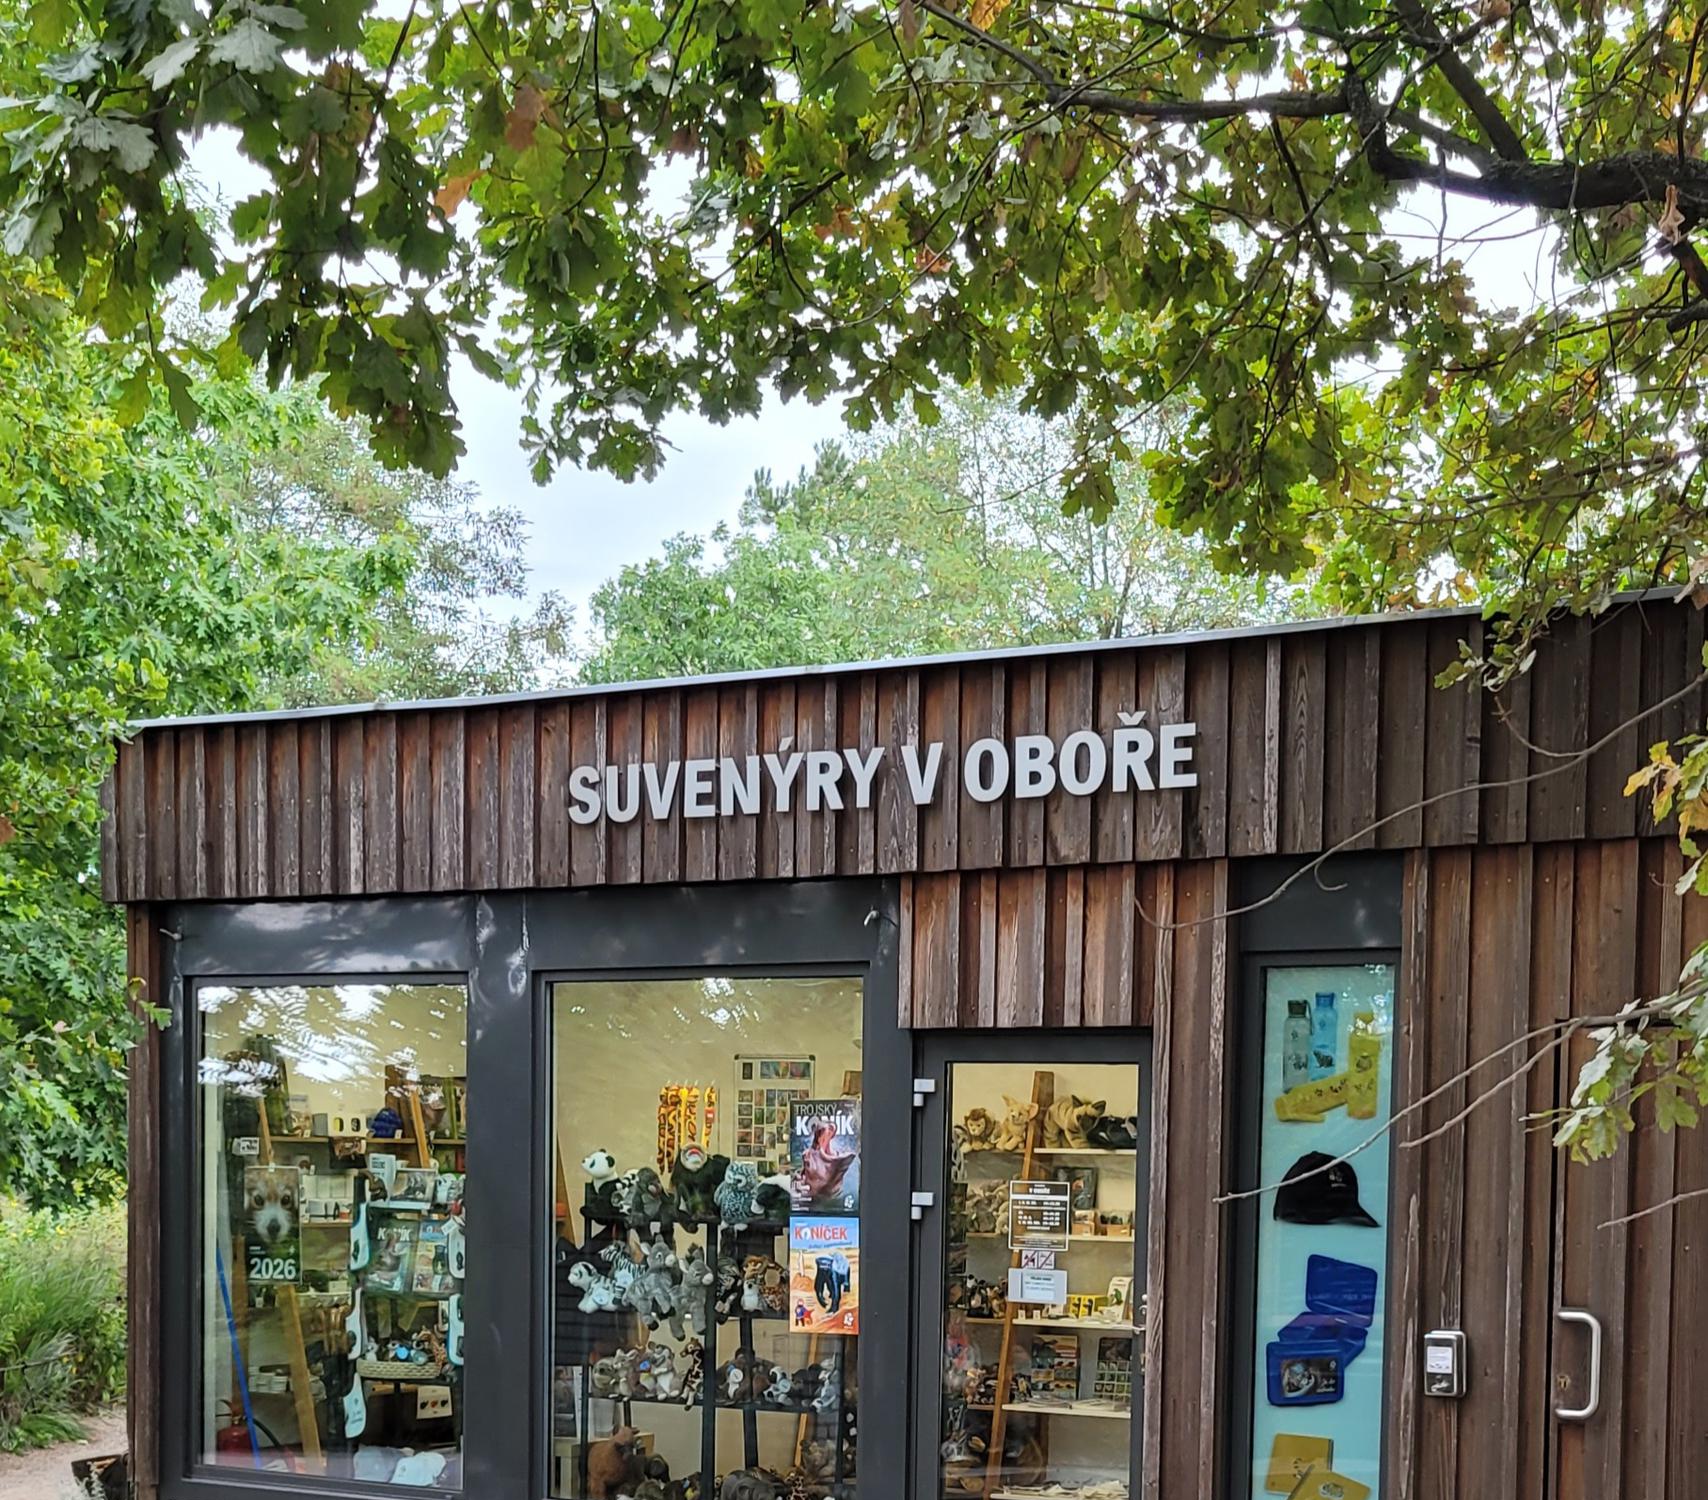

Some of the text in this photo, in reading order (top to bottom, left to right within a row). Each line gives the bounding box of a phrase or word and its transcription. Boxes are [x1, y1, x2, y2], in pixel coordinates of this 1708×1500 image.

[567, 709, 1199, 826] SUVENÝRY V OBOŘE
[793, 1102, 838, 1116] TROJSKÝ
[794, 1224, 848, 1241] KONÍČEK
[249, 1257, 296, 1280] 2026
